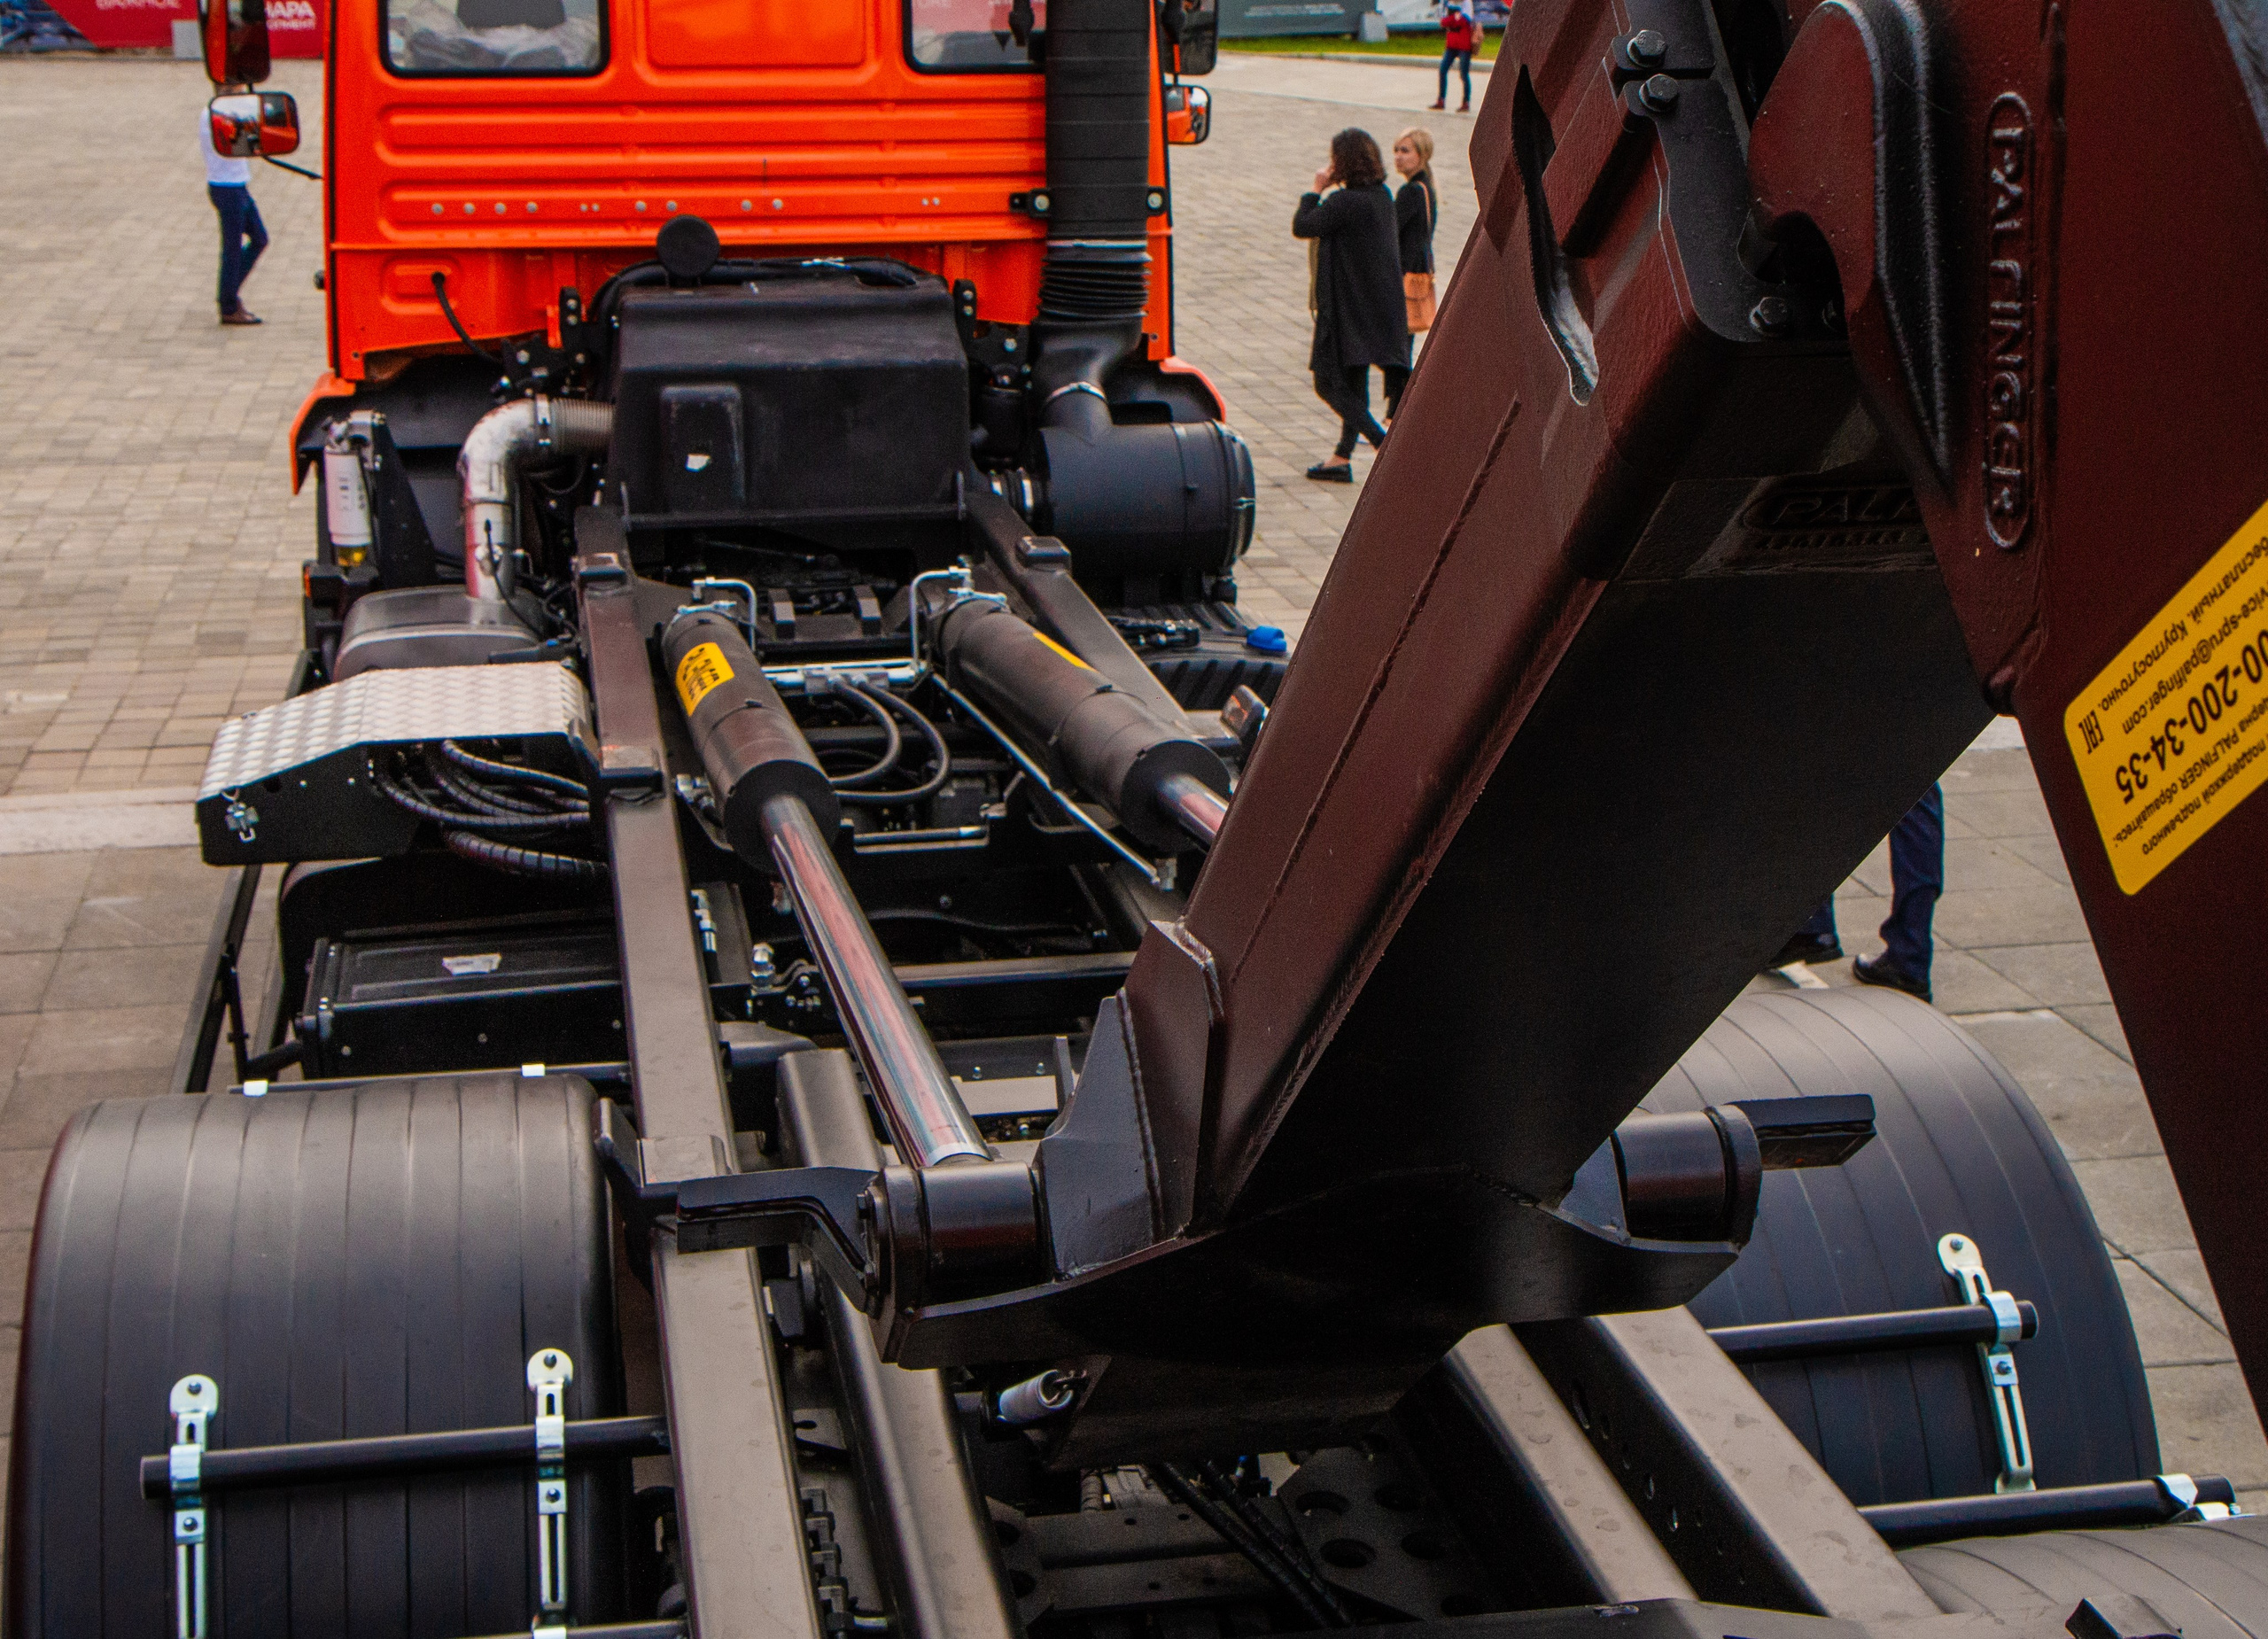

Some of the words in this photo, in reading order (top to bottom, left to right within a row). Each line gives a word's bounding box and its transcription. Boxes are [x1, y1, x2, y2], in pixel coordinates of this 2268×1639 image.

[1990, 127, 2024, 517] PALFINGER
[2098, 619, 2188, 711] Круглосуточно.
[2122, 578, 2268, 735] vice-spru@palfinger.com
[2178, 727, 2240, 790] PALFINGER
[2201, 739, 2267, 804] поддержкой
[2141, 796, 2202, 856] подъемного
